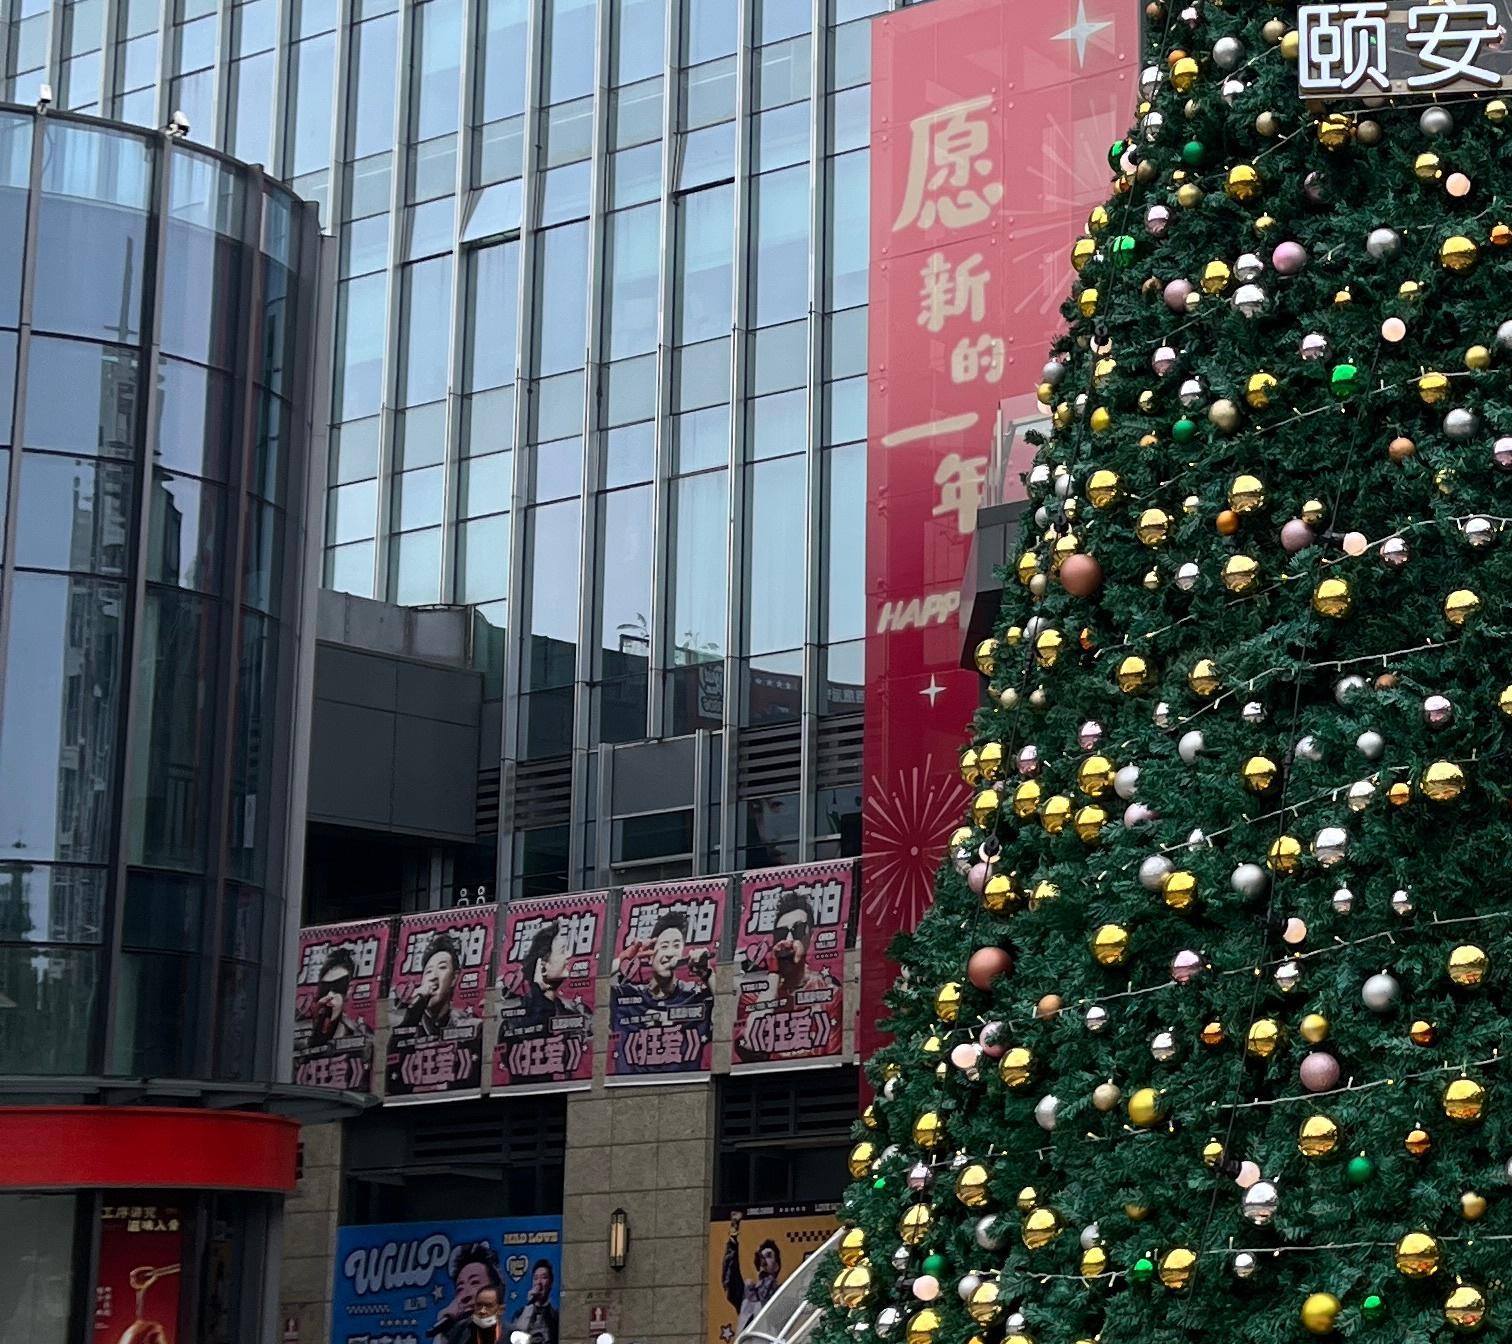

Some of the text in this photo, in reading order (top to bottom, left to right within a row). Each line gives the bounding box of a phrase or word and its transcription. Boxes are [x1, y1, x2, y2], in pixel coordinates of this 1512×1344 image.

[882, 94, 1006, 536] 愿新的一年
